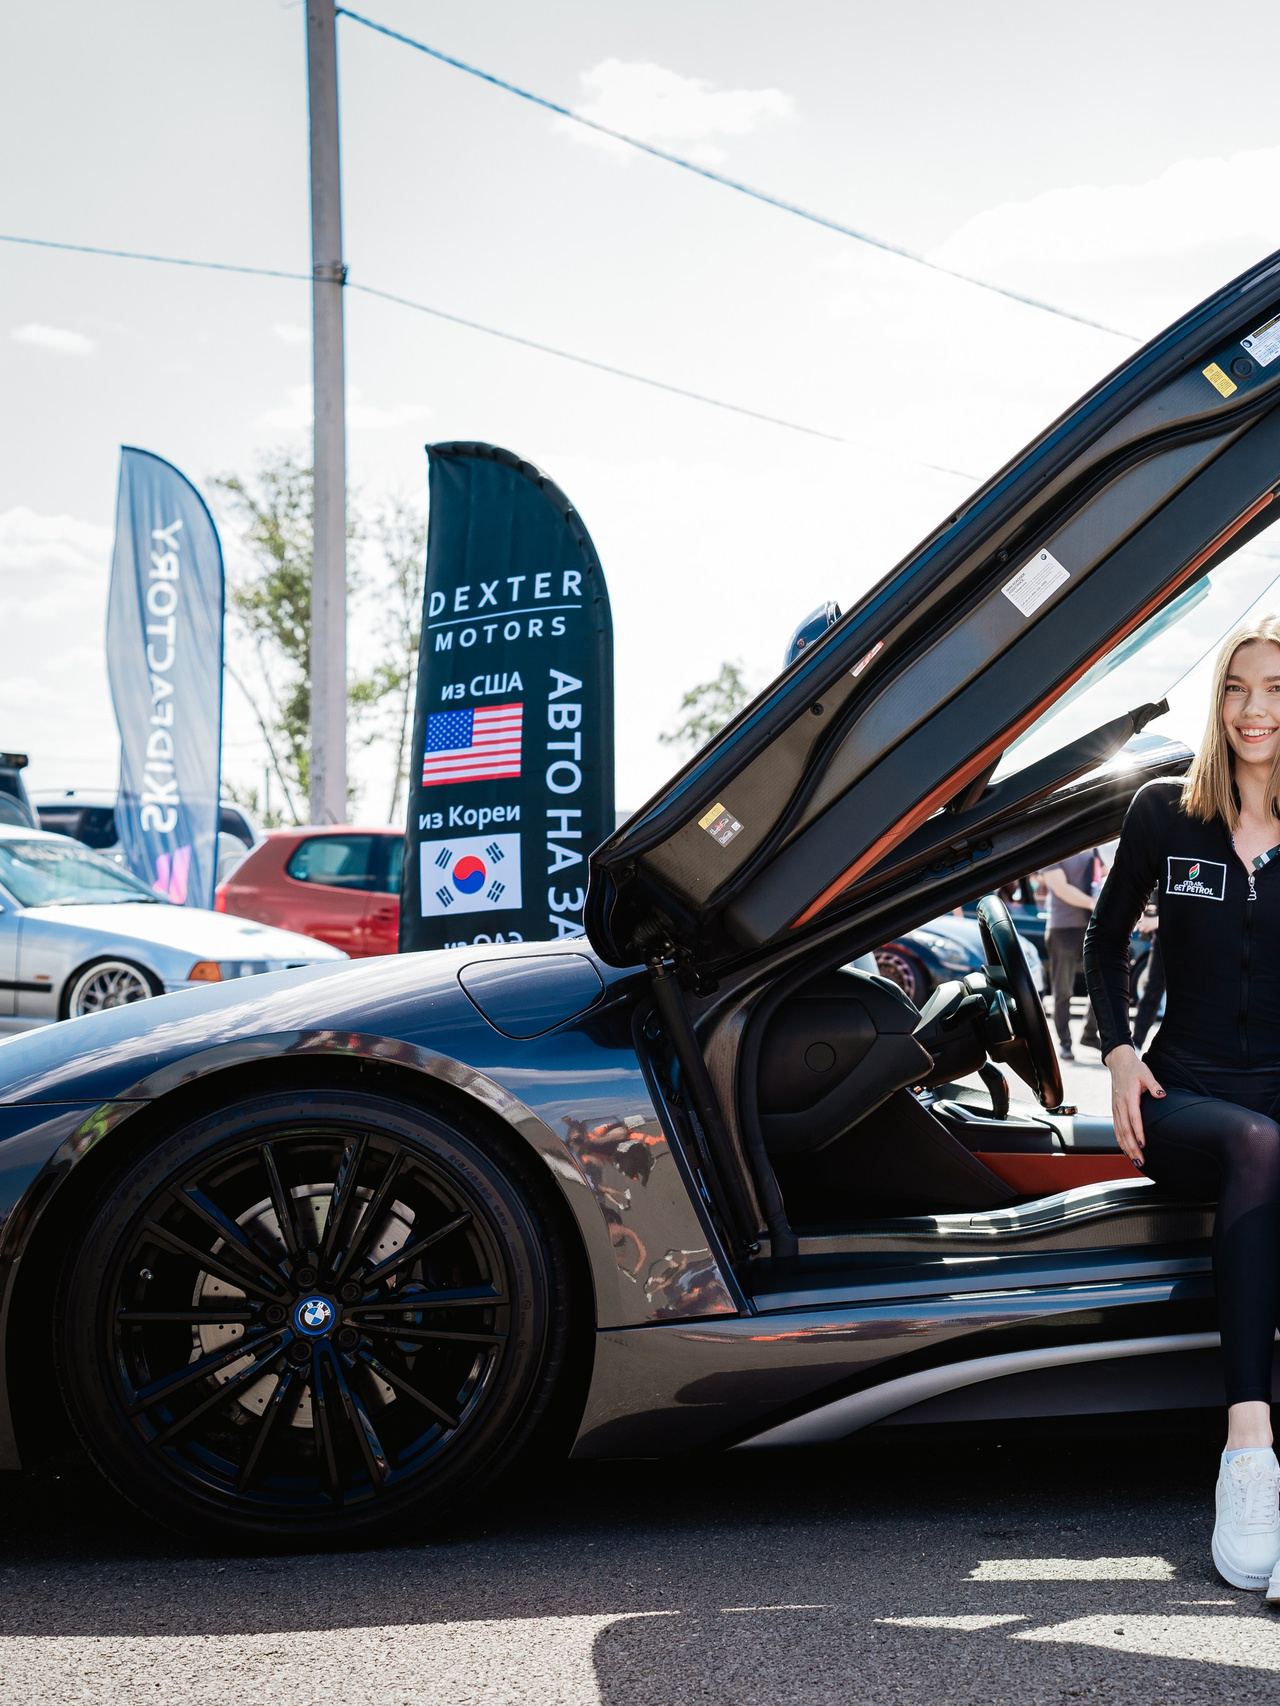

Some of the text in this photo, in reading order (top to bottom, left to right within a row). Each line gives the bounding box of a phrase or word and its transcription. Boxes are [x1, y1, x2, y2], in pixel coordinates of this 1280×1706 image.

[428, 570, 583, 617] DEXTER
[435, 616, 566, 652] MOTORS
[441, 671, 524, 701] из США
[546, 668, 583, 795] АВТО
[418, 804, 521, 831] из Кореи
[546, 809, 583, 875] НА
[1174, 884, 1214, 895] GET PETROL
